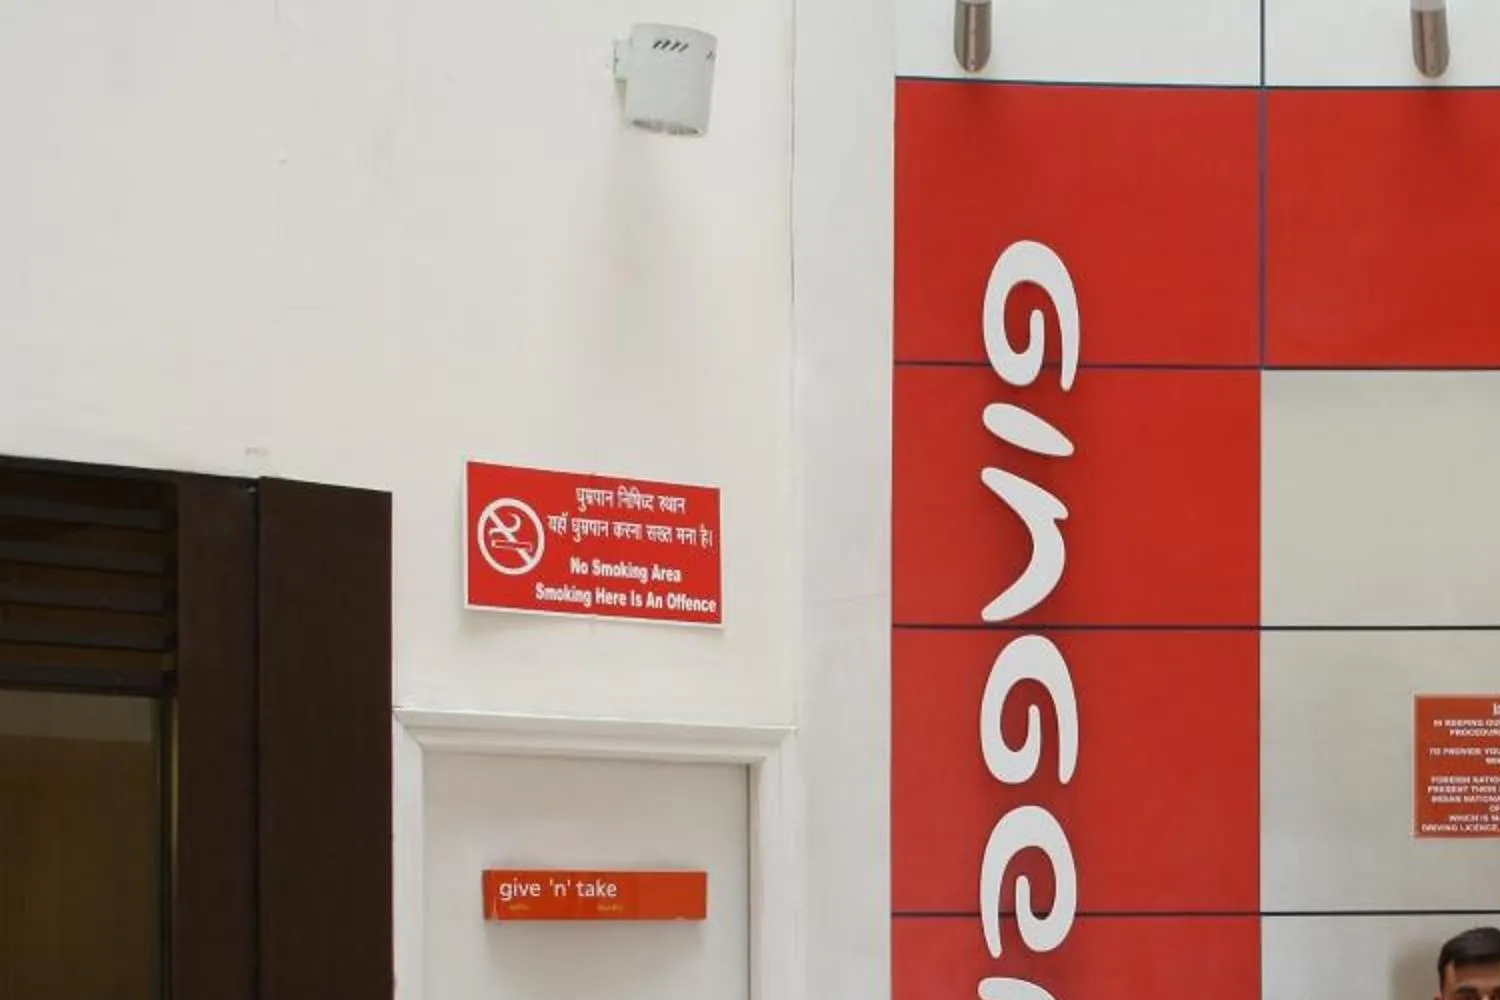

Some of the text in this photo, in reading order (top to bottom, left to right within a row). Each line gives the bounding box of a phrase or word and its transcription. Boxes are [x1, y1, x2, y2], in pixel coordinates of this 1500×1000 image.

[677, 527, 697, 546] मना
[570, 556, 681, 584] No Smoking Area
[535, 583, 717, 613] Smoking Here Is An Offence
[1430, 747, 1441, 756] TO
[1428, 785, 1469, 793] PRESENT
[499, 877, 541, 901] give
[575, 880, 617, 898] take
